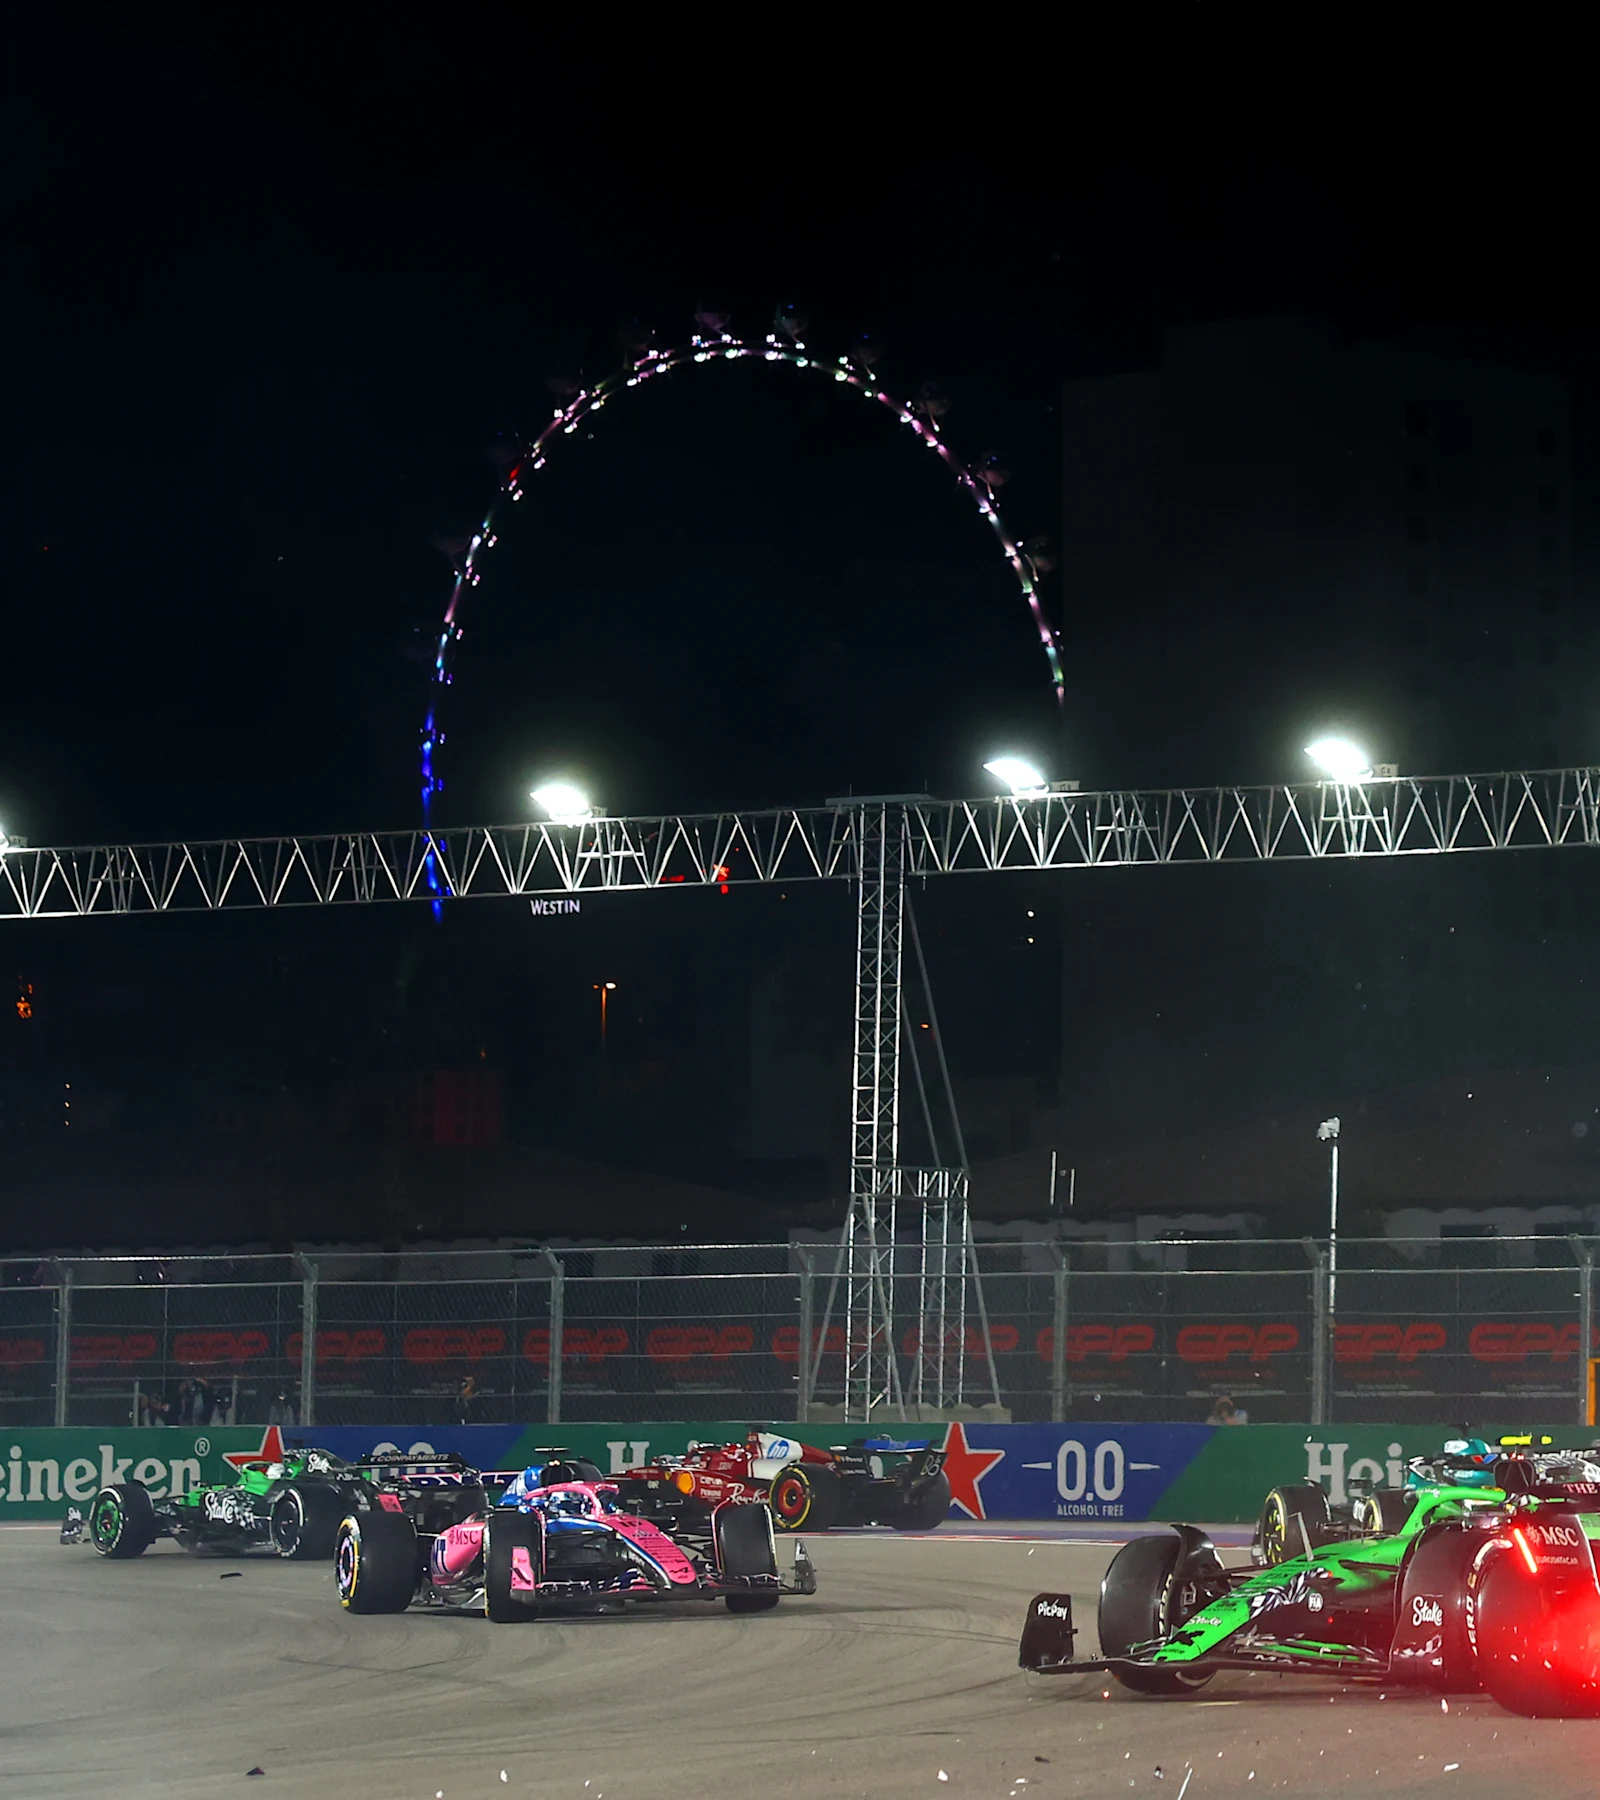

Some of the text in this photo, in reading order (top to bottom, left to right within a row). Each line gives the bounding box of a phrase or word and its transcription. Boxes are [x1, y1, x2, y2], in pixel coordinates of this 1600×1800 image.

[530, 899, 580, 916] WESTIN
[378, 1454, 450, 1462] COINPAYMENTS
[0, 1445, 201, 1502] ineken
[1057, 1440, 1124, 1501] 0.0
[1563, 1483, 1597, 1495] THE
[205, 1493, 234, 1524] Stake
[1057, 1505, 1124, 1516] ALCOHOL FREE
[455, 1529, 479, 1545] MSC
[1539, 1526, 1579, 1546] MSC
[1037, 1600, 1068, 1621] PicPay
[1413, 1596, 1443, 1626] Stake
